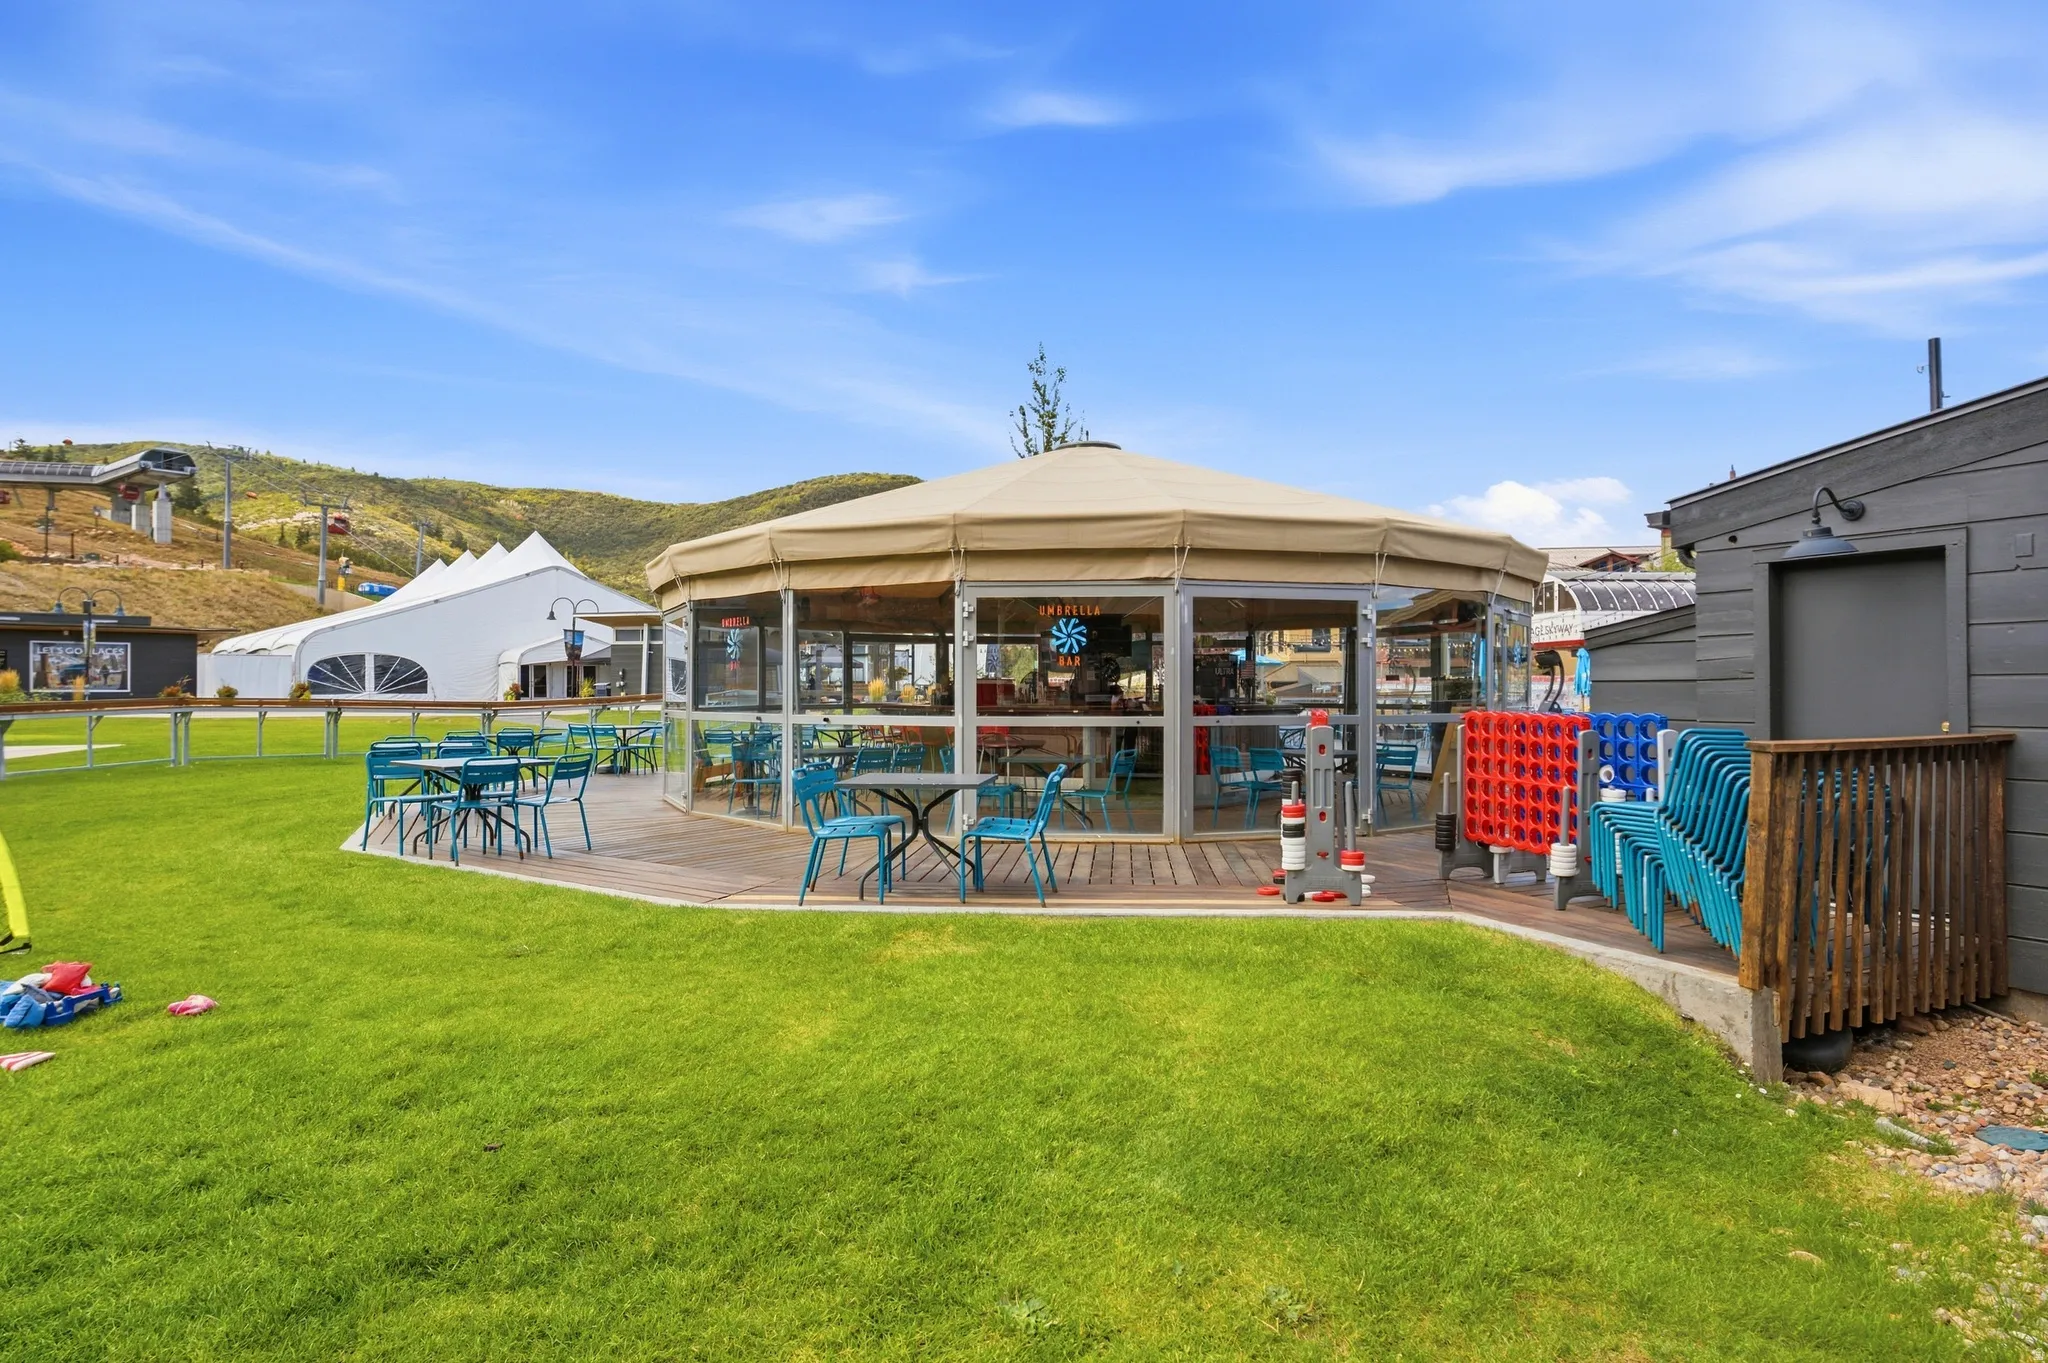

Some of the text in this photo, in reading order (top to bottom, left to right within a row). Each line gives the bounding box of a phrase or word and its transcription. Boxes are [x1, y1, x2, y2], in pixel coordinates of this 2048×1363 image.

[1039, 605, 1101, 616] UMBRELLA
[1545, 623, 1573, 636] SKYWAY
[65, 647, 83, 655] GO
[87, 647, 125, 656] LACES
[1059, 656, 1080, 667] BAR
[1215, 667, 1234, 676] ULTRA
